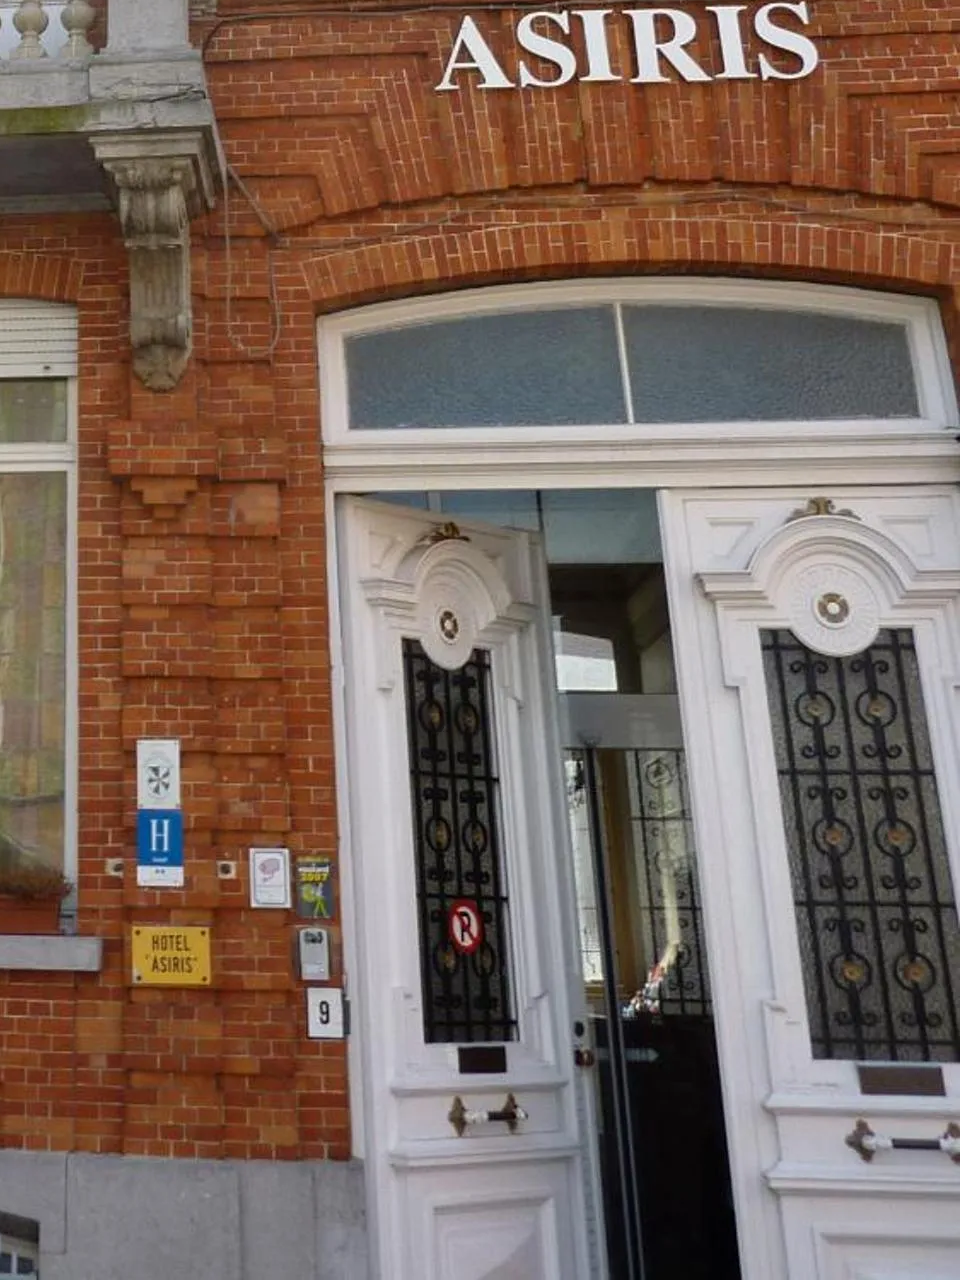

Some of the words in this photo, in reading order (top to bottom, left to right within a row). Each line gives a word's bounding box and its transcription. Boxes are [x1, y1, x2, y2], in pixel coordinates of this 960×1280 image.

[434, 0, 819, 91] ASIRIS
[150, 819, 170, 852] H
[151, 934, 191, 953] HOTEL
[320, 1000, 330, 1025] 9
